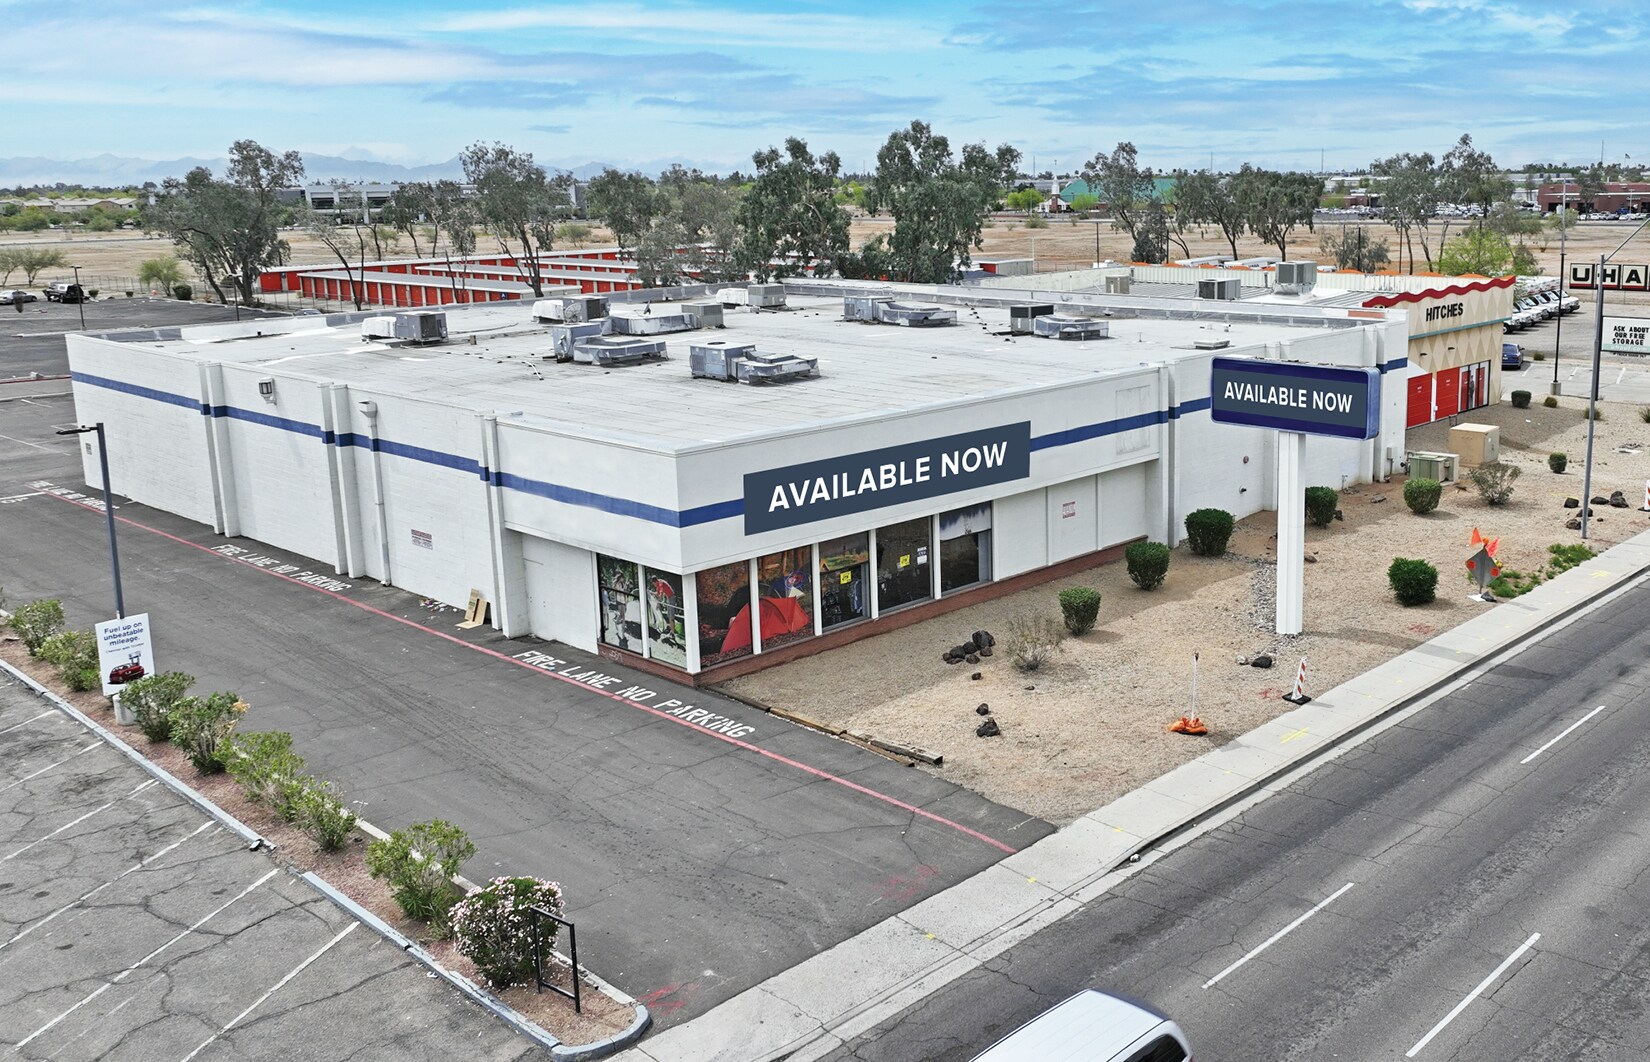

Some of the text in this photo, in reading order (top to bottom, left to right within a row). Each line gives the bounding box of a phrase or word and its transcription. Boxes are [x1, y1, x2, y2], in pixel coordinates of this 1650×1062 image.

[1425, 302, 1464, 322] HITCHES
[1612, 338, 1644, 346] STORAGE
[1224, 381, 1353, 413] AVAILABLE NOW
[768, 441, 1007, 513] AVAILABLE NOW
[211, 543, 352, 592] FIRE LANE NO PARKING
[103, 628, 143, 640] unbeatable
[104, 626, 121, 635] Fuel
[512, 650, 756, 738] FIRE LANE NO PARKING
